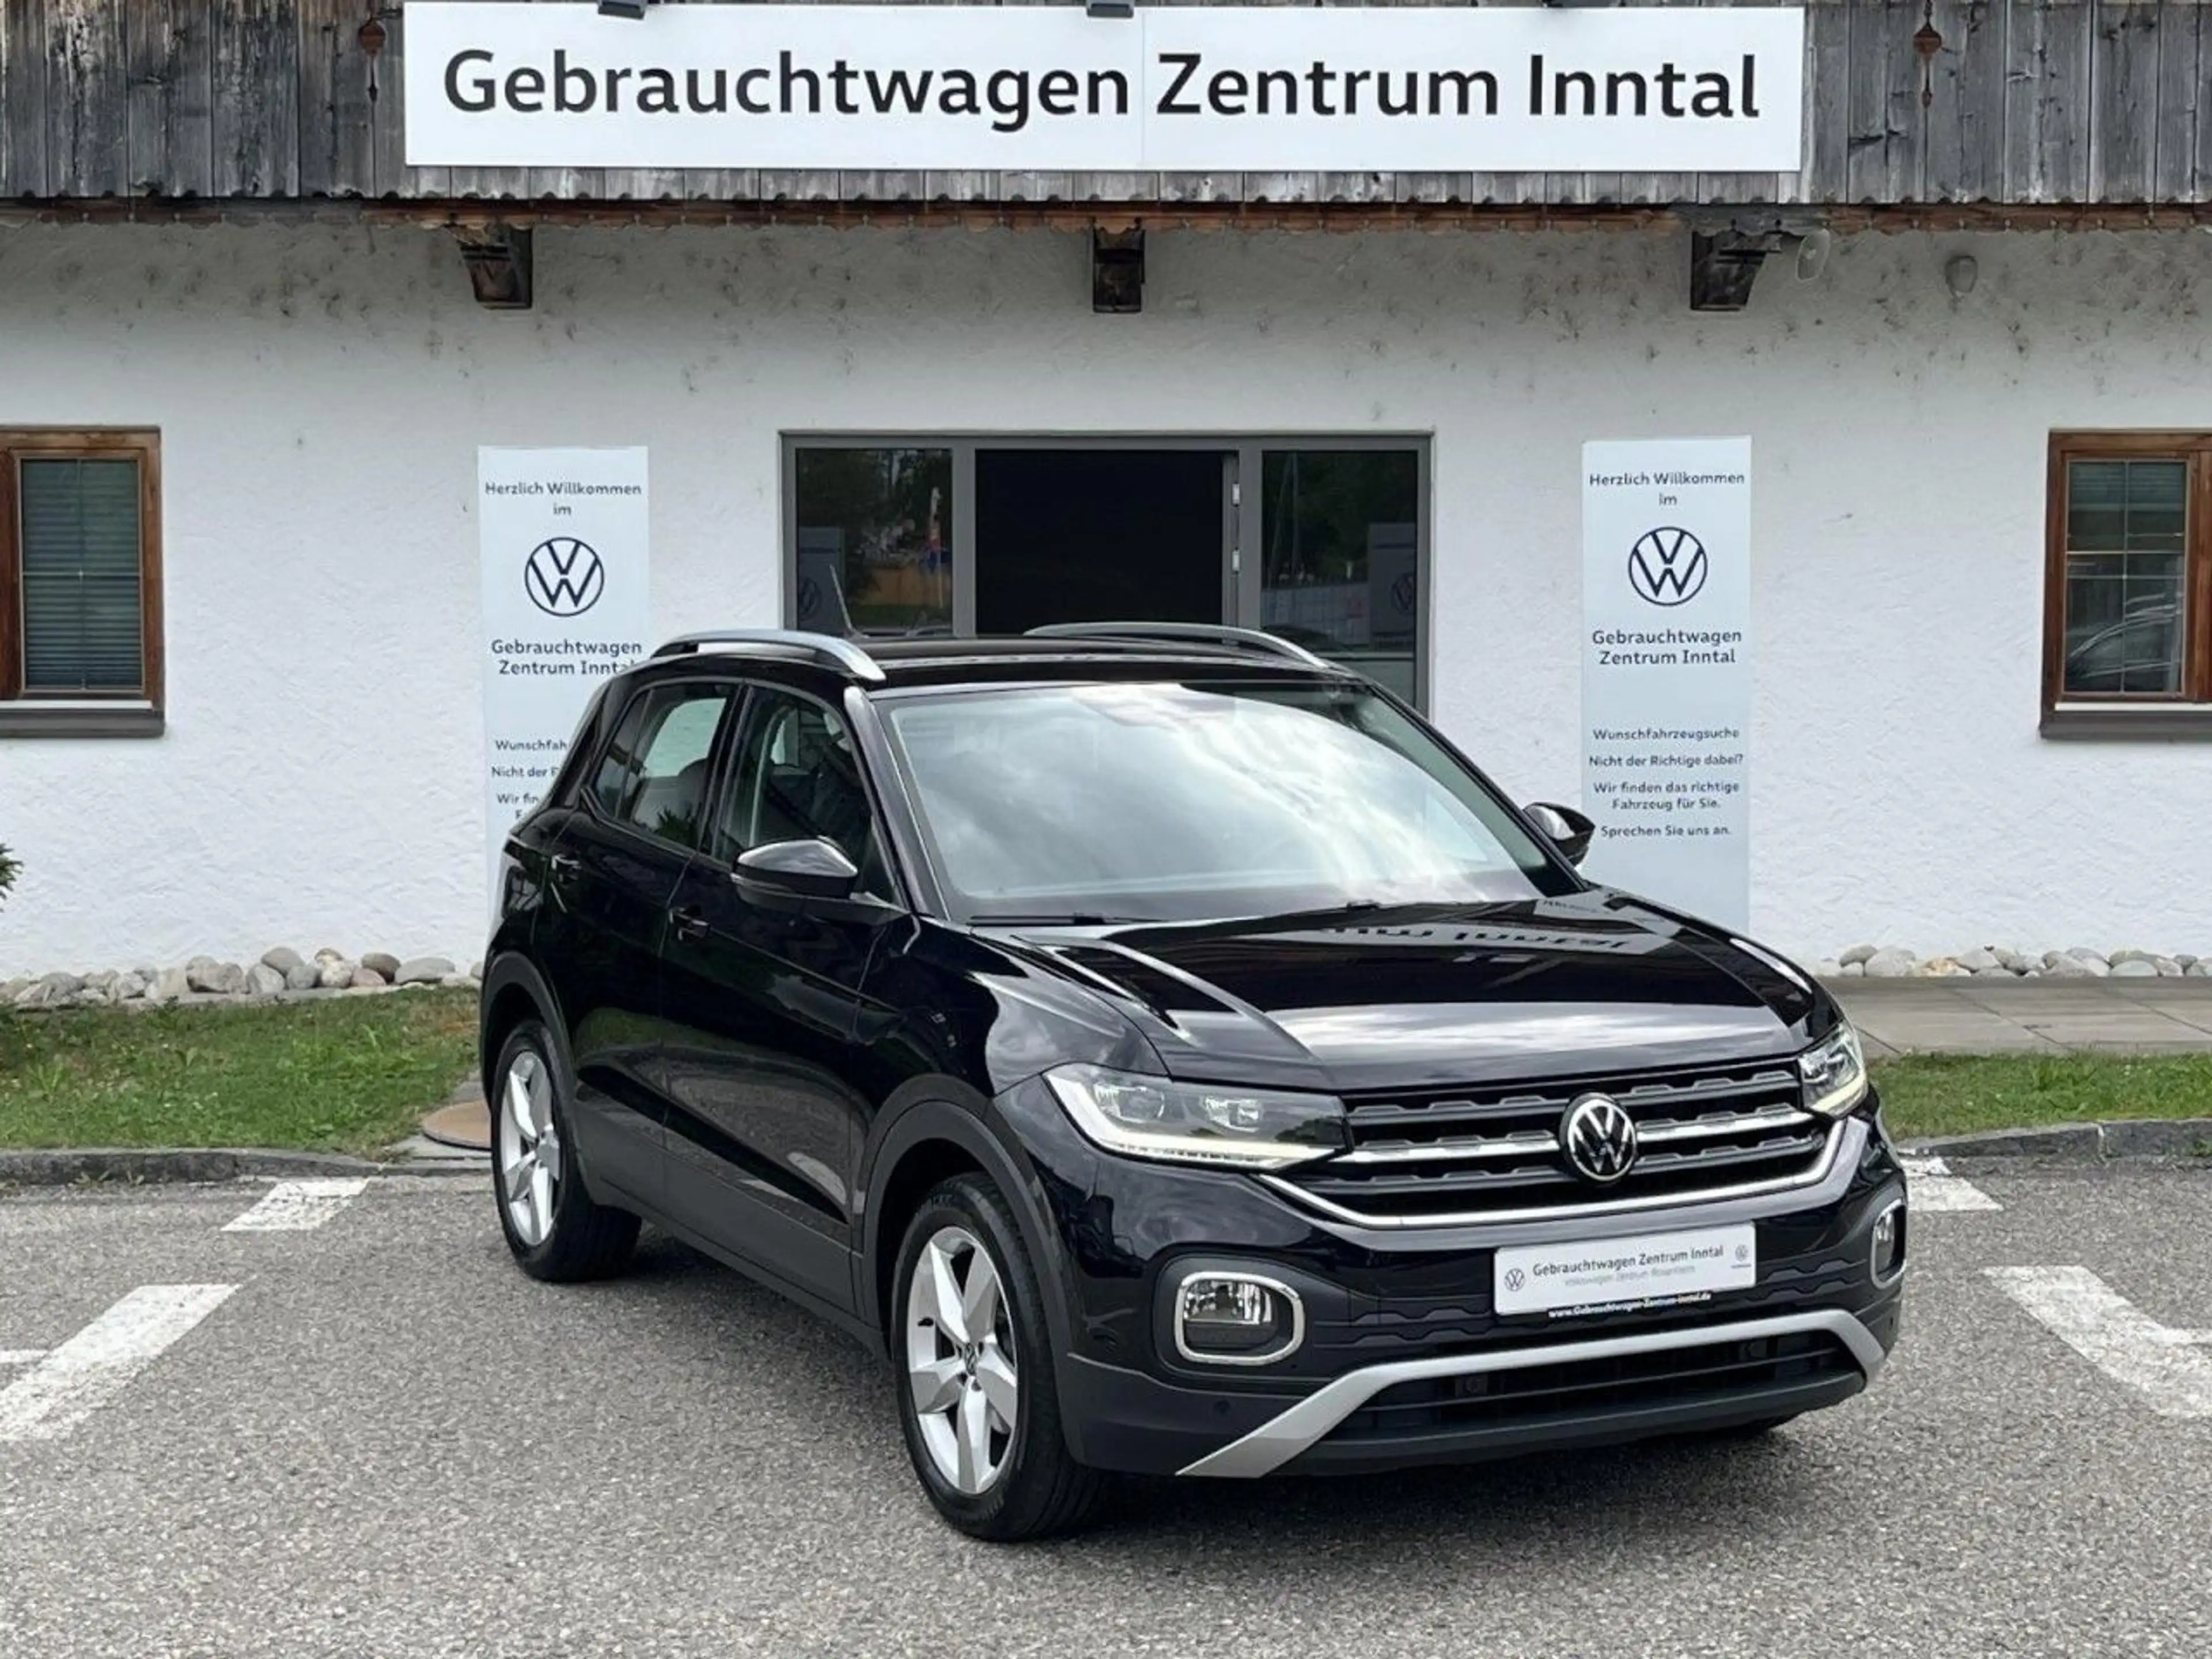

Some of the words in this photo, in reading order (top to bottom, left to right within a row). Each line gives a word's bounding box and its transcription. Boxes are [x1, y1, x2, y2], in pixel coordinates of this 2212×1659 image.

[444, 48, 1128, 133] Gebrauchtwagen
[1156, 53, 1499, 117] Zentrum
[1529, 54, 1760, 119] Inntal
[1589, 472, 1650, 486] Herzlich
[1653, 471, 1745, 485] Willkommen
[485, 482, 543, 495] Herzlich
[547, 482, 642, 495] Willkommen
[1658, 493, 1677, 506] im
[553, 503, 571, 515] im
[1592, 628, 1741, 646] Gebrauchtwagen
[491, 639, 642, 658] Gebrauchtwagen
[1599, 650, 1677, 665] Zentrum
[1683, 648, 1736, 664] Inntal
[499, 659, 575, 675] Zentrum
[1593, 728, 1740, 741] Wunschfahrzeugsuche
[1589, 756, 1622, 767] Nicht
[1626, 755, 1647, 767] der
[1650, 754, 1702, 768] Richtige
[1703, 753, 1744, 766] dabei?
[491, 767, 525, 777] Nicht
[527, 767, 548, 778] der
[1593, 782, 1617, 794] Wir
[1620, 781, 1662, 794] finden
[1665, 781, 1688, 793] das
[1691, 781, 1740, 795] richtige
[497, 794, 520, 804] Wir
[1612, 798, 1673, 812] Fahrzeug
[1677, 797, 1695, 809] für
[1699, 797, 1721, 809] Sie.
[1601, 825, 1662, 838] Sprechen
[1665, 824, 1685, 836] Sie
[1687, 826, 1710, 836] uns
[1532, 1257, 1636, 1277] Gebrauchtwagen
[1638, 1251, 1688, 1266] Zentrum
[1691, 1244, 1724, 1259] Inntal
